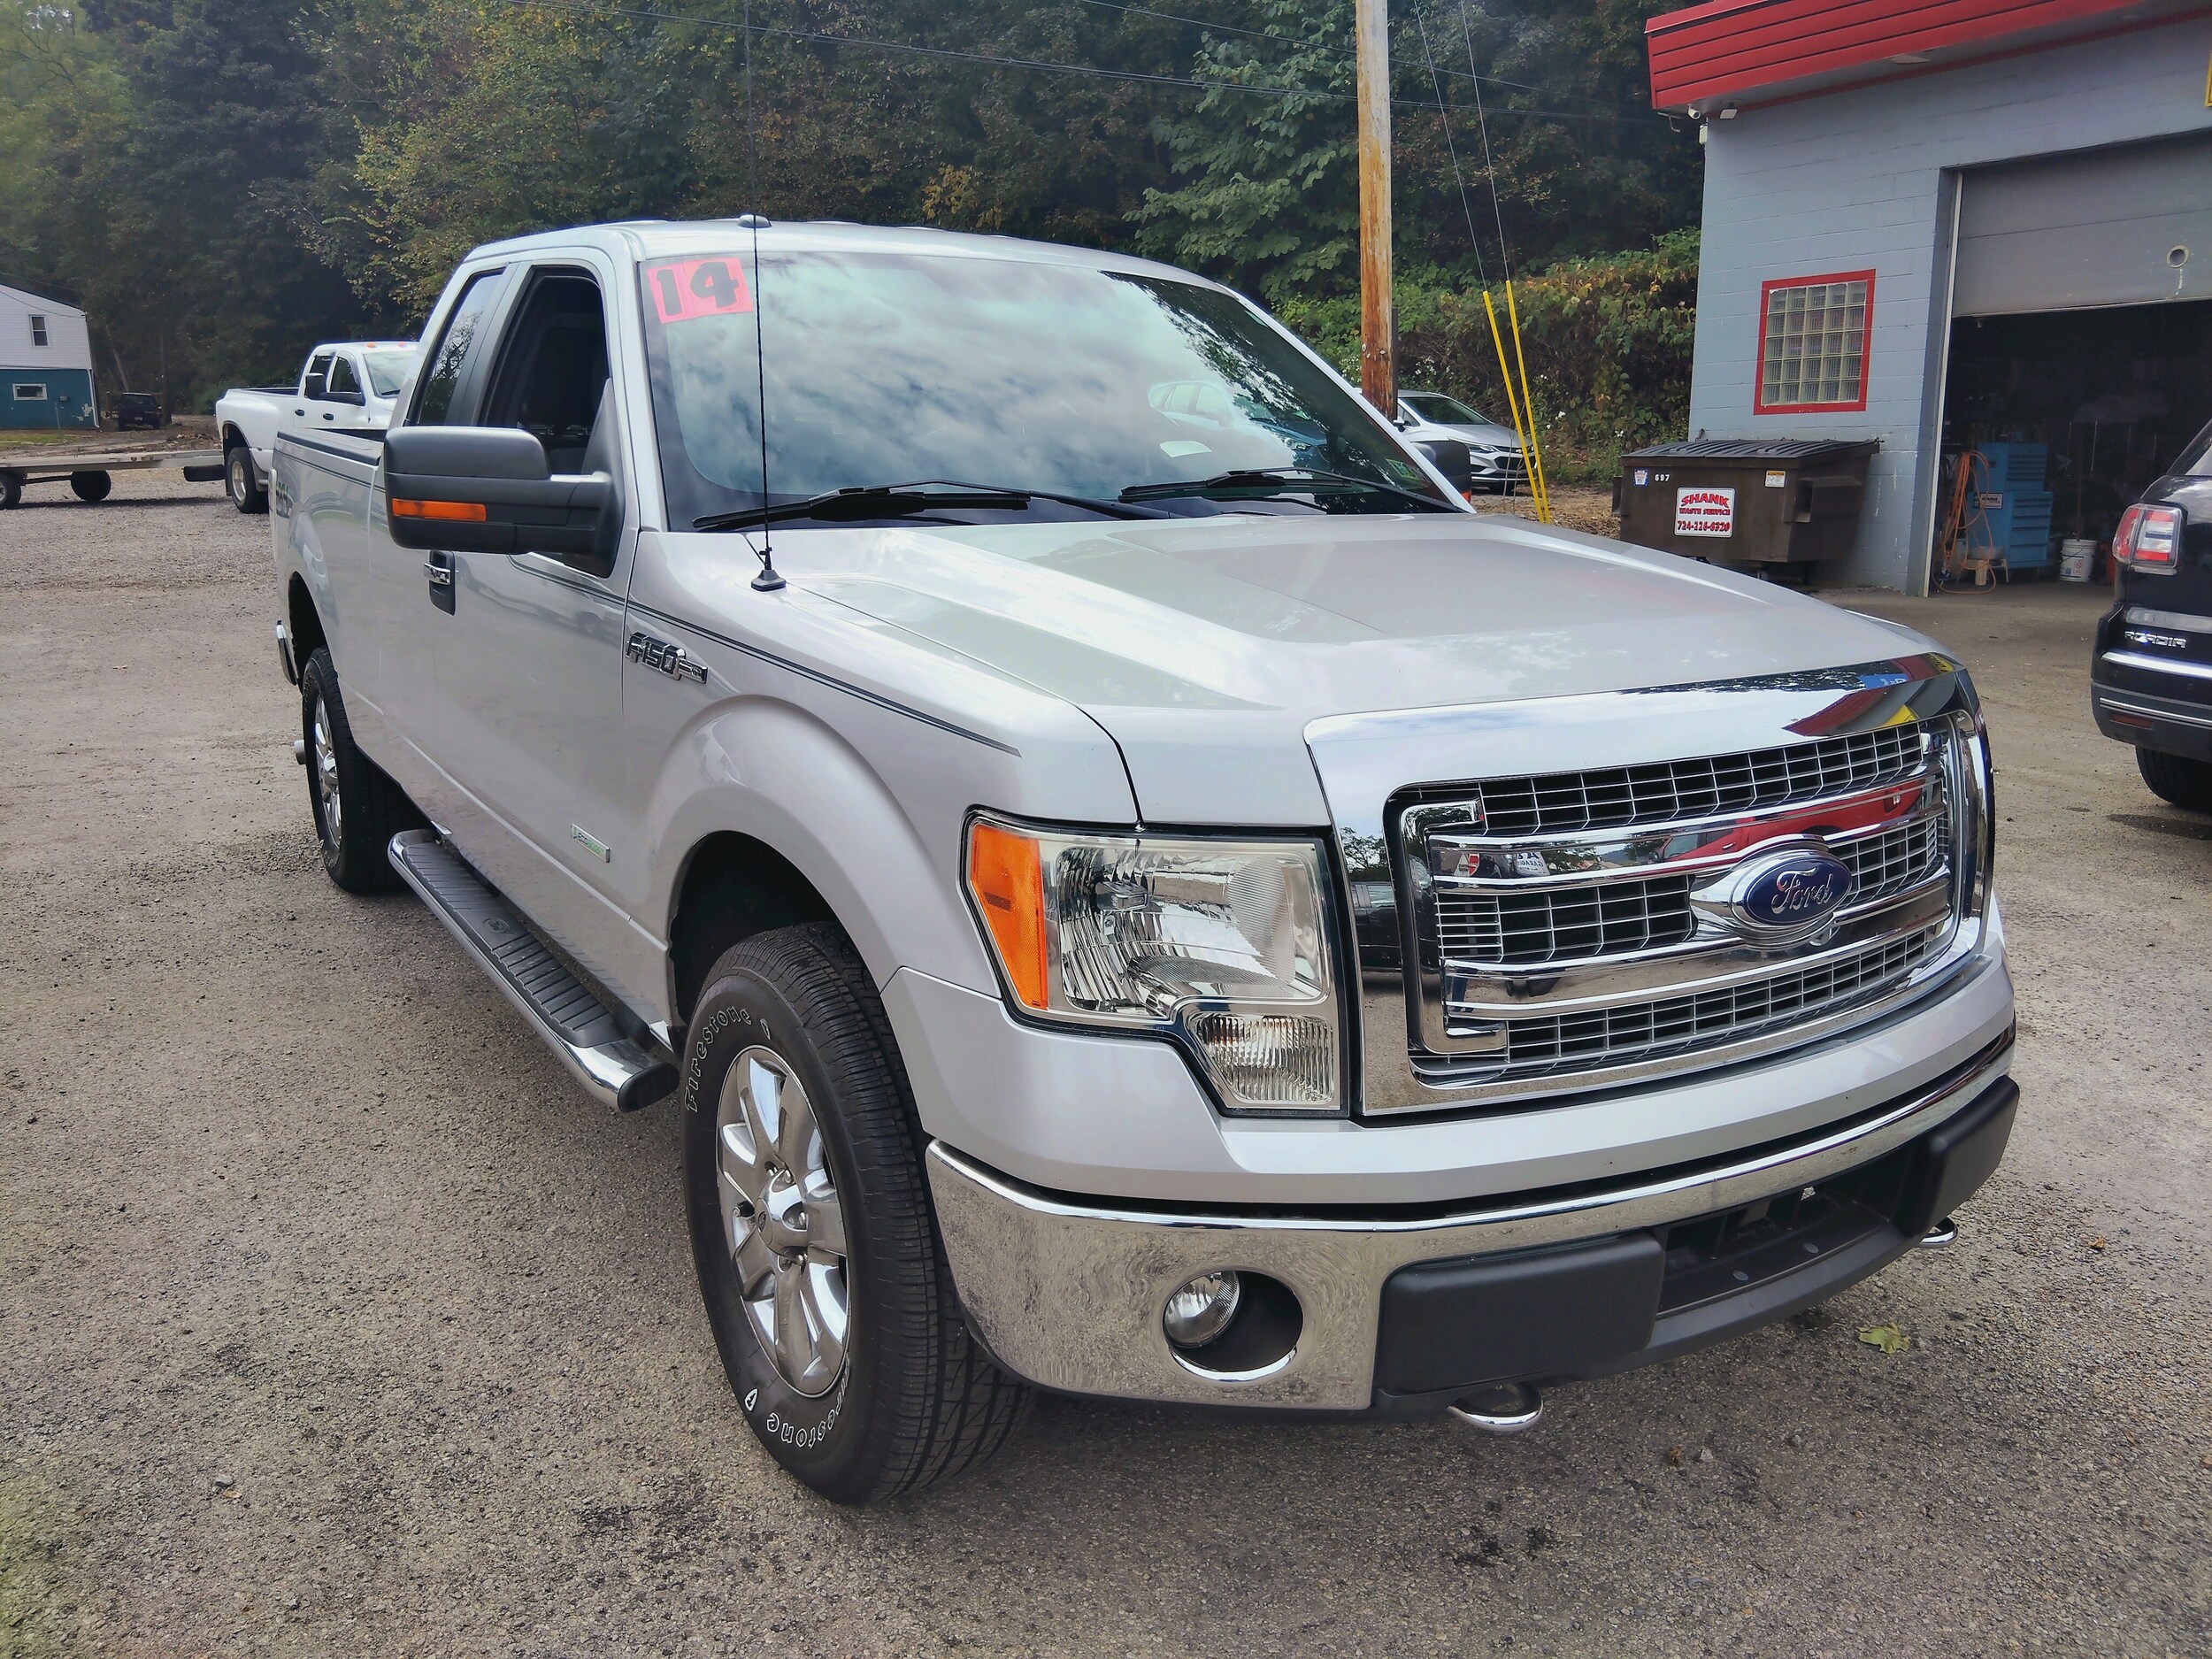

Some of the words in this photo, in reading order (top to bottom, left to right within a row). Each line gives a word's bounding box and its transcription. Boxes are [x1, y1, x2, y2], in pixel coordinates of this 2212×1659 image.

[657, 261, 740, 316] 14
[1655, 473, 1671, 482] 697
[1680, 492, 1730, 509] SHANK
[2124, 631, 2187, 649] ACADIA
[1770, 867, 1834, 915] Ford
[684, 1005, 752, 1113] Firestone
